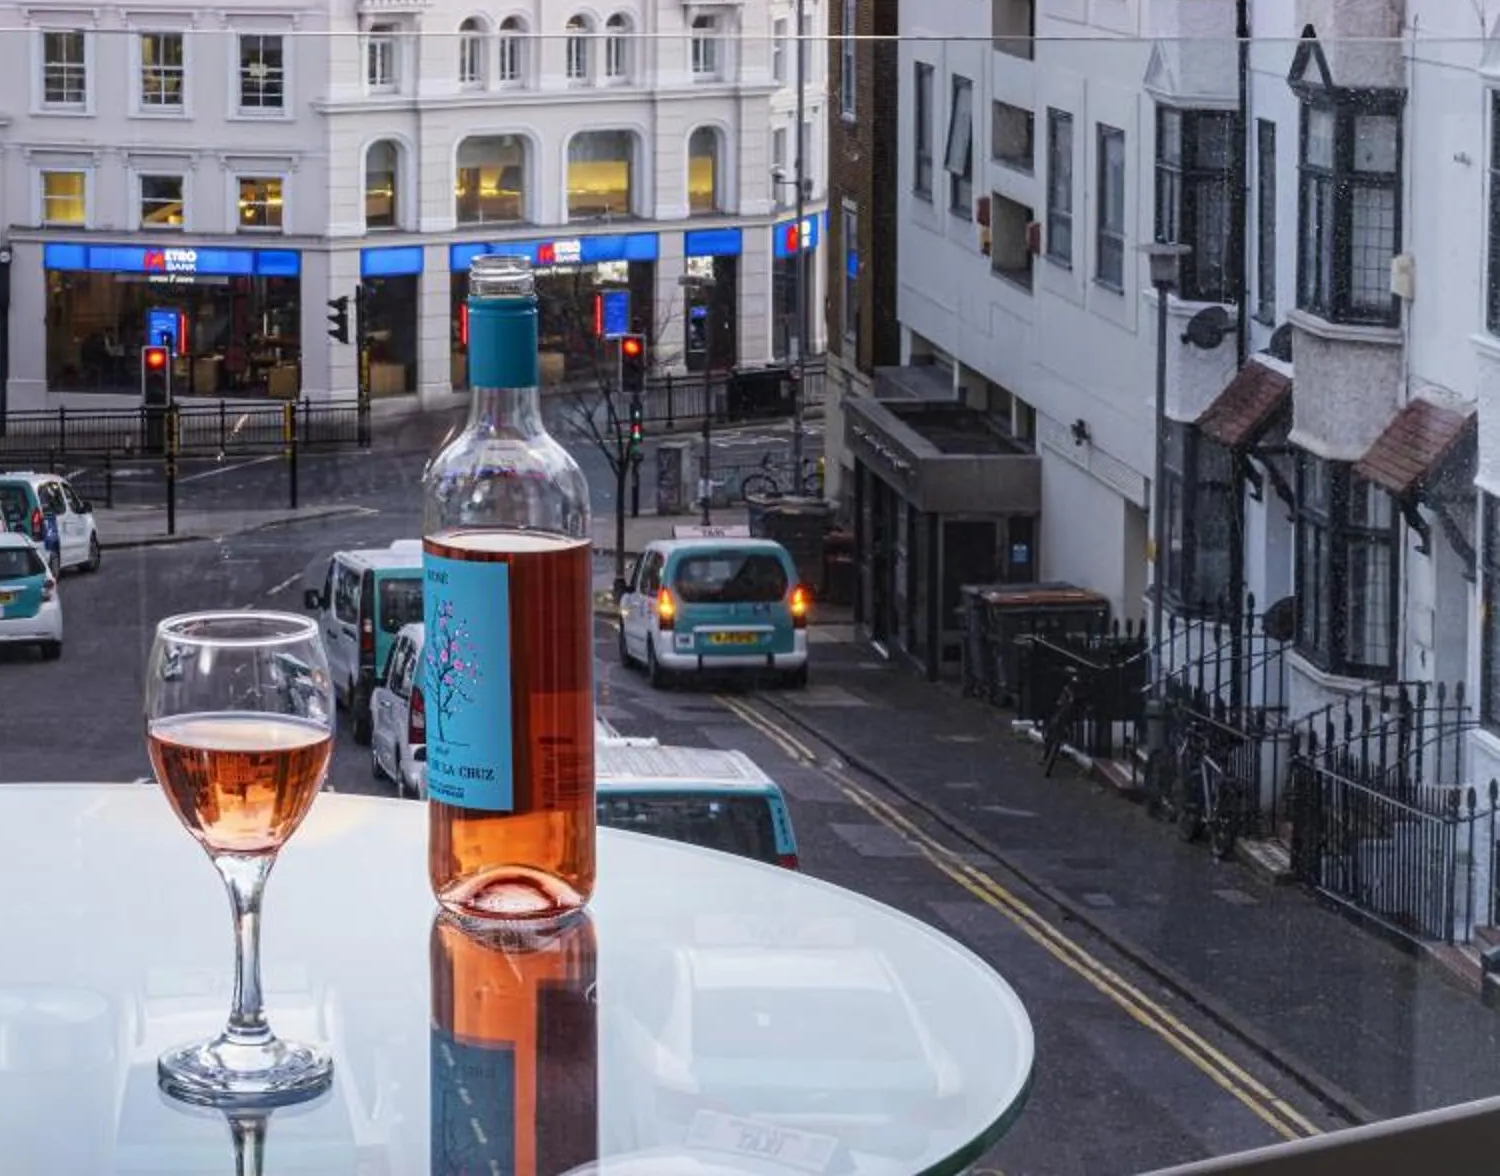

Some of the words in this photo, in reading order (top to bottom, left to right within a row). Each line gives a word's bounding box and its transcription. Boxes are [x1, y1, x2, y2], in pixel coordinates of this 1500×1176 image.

[144, 248, 197, 273] METRO
[166, 262, 197, 272] BANK
[459, 767, 495, 781] CRUZ
